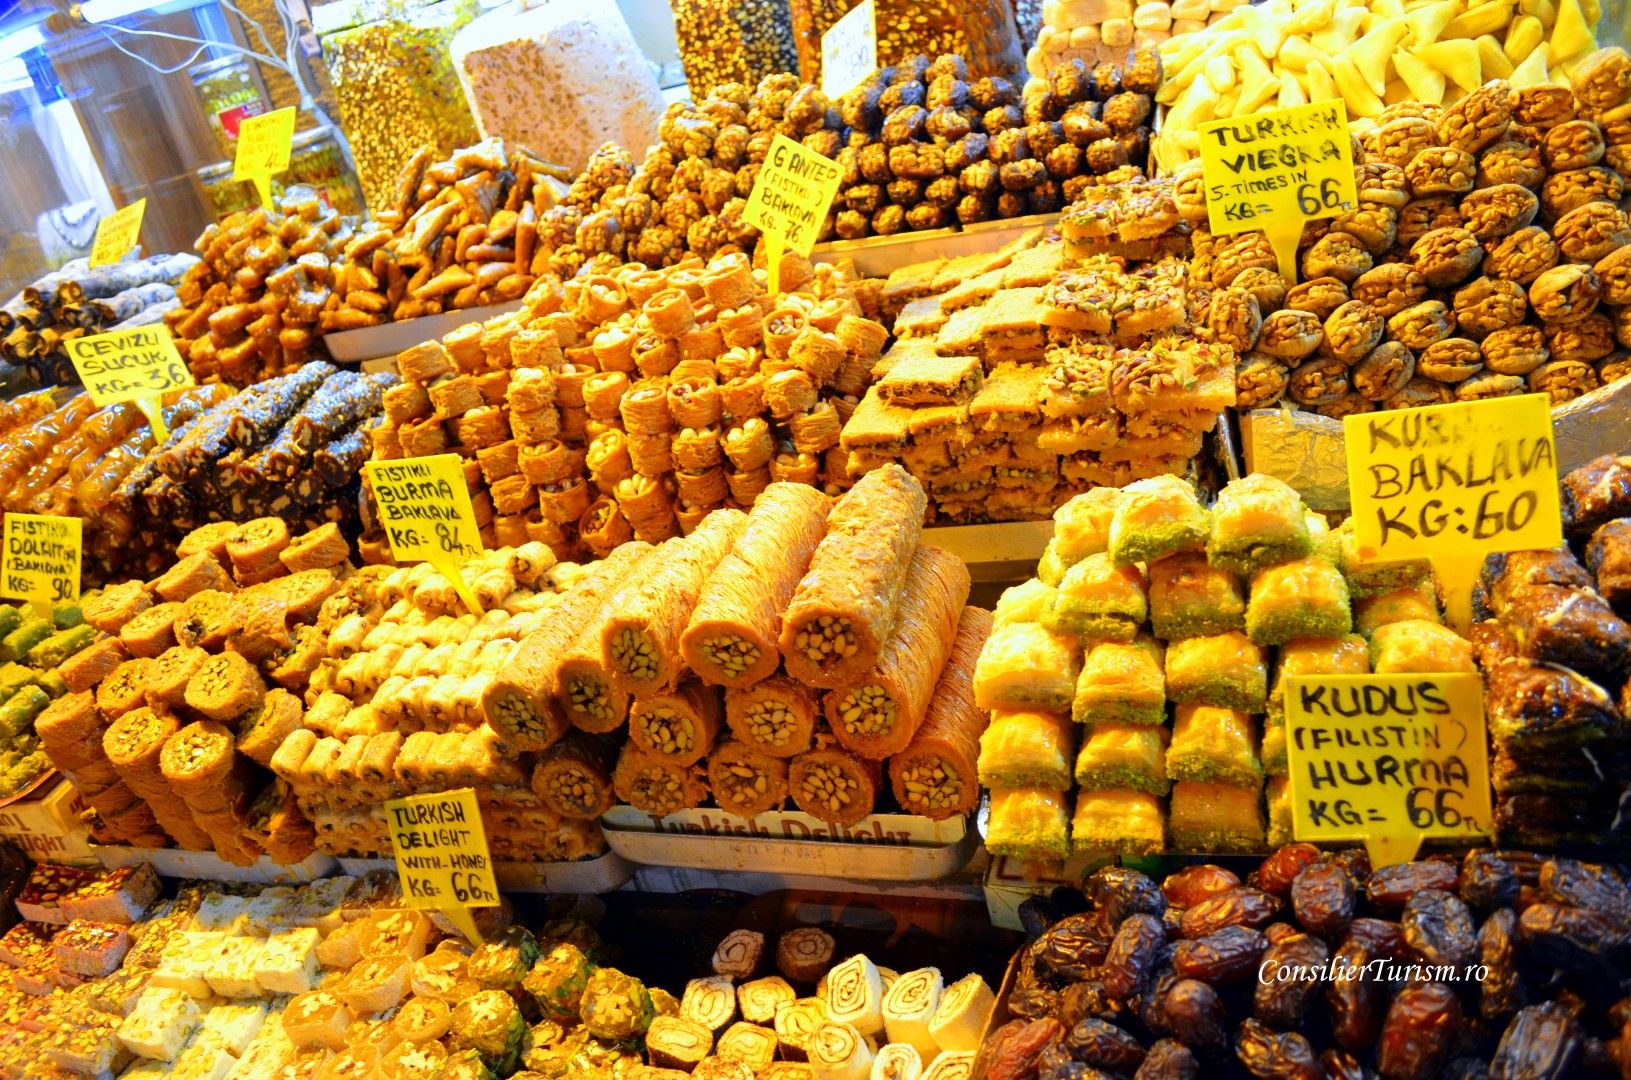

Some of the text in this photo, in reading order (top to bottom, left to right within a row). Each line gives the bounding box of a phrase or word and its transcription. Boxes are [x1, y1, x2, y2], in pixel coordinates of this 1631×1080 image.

[82, 351, 168, 376] SUCUK
[143, 362, 187, 390] 36
[1369, 436, 1554, 500] BAKLAVA
[376, 479, 454, 503] BURMA
[50, 577, 73, 602] 90
[1300, 681, 1452, 717] KUDUS
[1307, 754, 1470, 790] HURMA
[391, 800, 467, 828] TURKISH
[397, 828, 471, 850] DELIGHT
